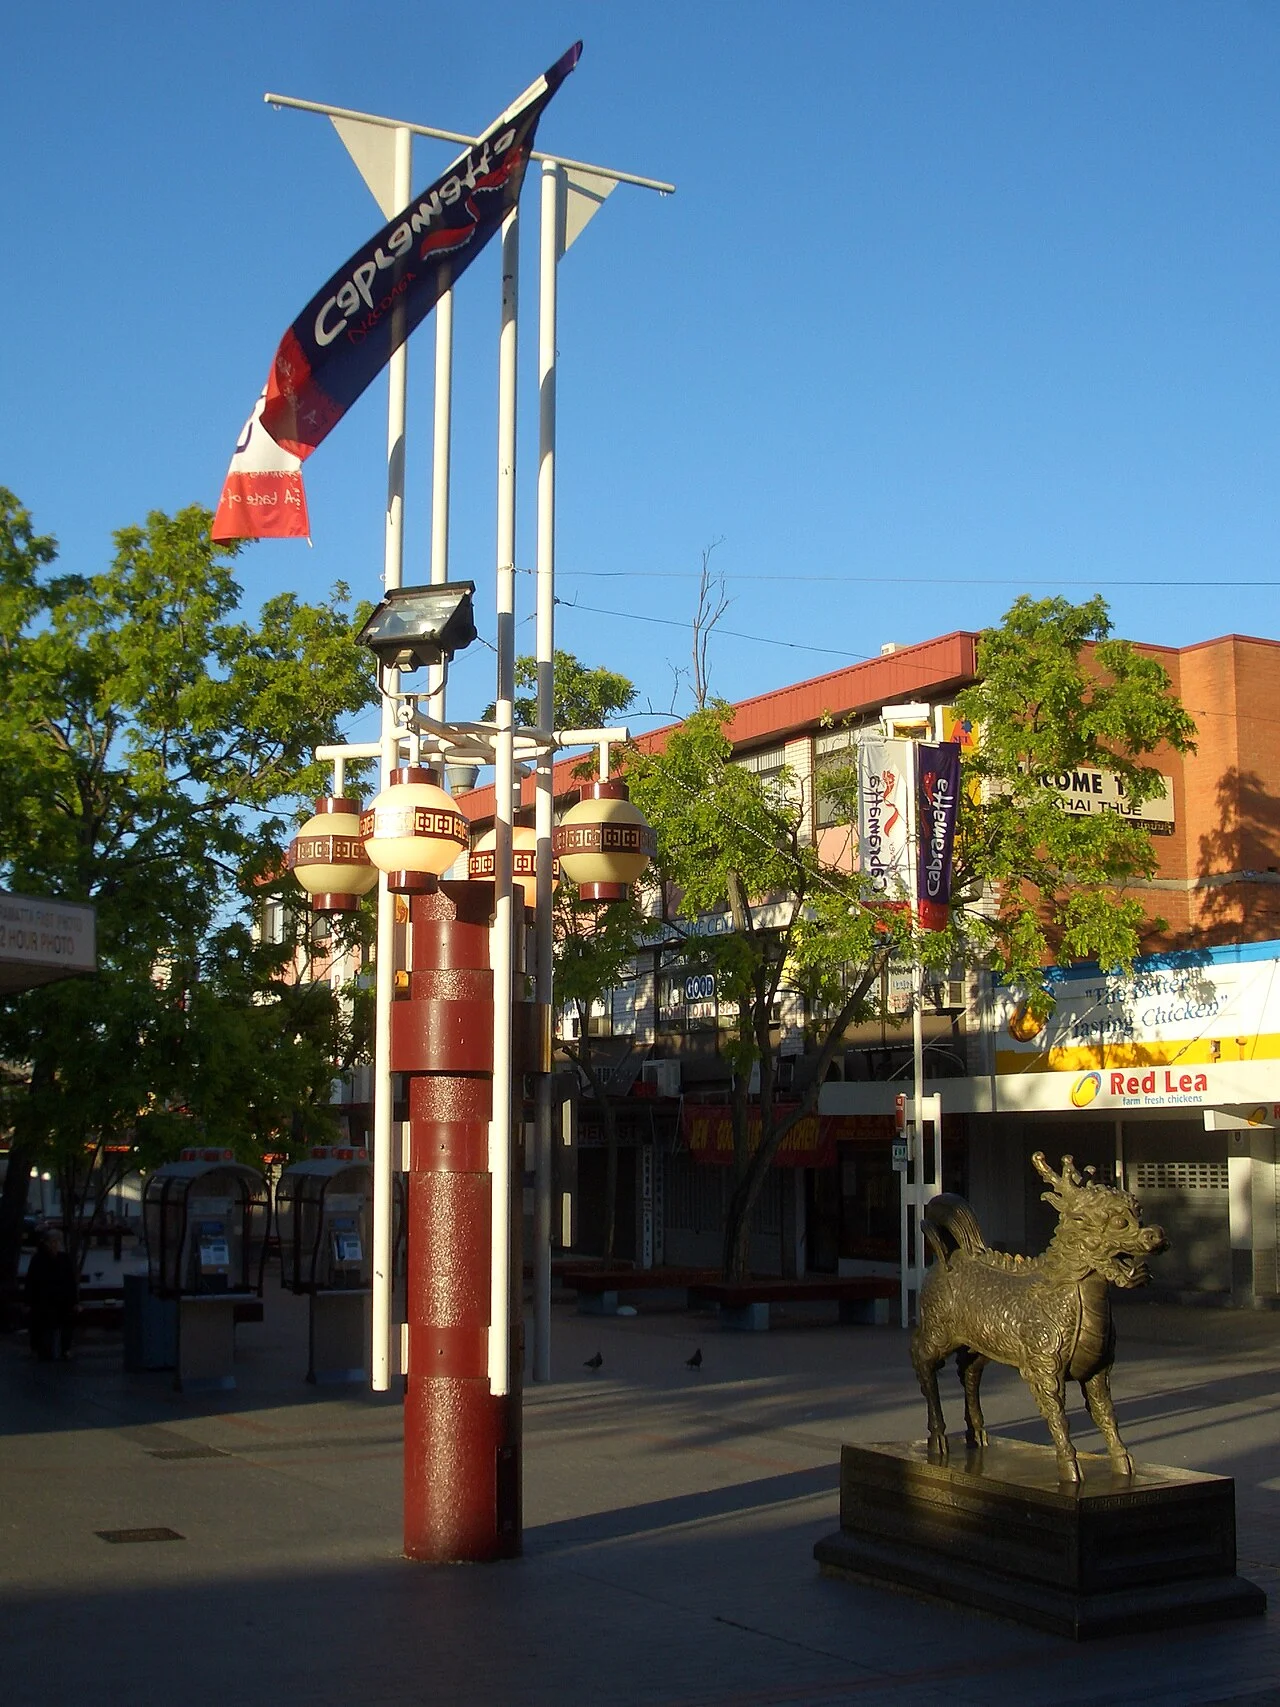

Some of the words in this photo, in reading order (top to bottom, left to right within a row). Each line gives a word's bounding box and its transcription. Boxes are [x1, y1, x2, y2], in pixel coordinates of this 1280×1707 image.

[1037, 770, 1103, 794] COME
[926, 778, 954, 897] Cabramatta
[9, 929, 38, 951] HOUR
[41, 933, 75, 956] PHOTO
[686, 975, 714, 1000] GOOD
[1110, 1071, 1156, 1096] Red
[1165, 1070, 1208, 1093] Lea
[1122, 1096, 1141, 1106] farm
[1144, 1095, 1165, 1105] fresh
[1167, 1094, 1203, 1104] chickens
